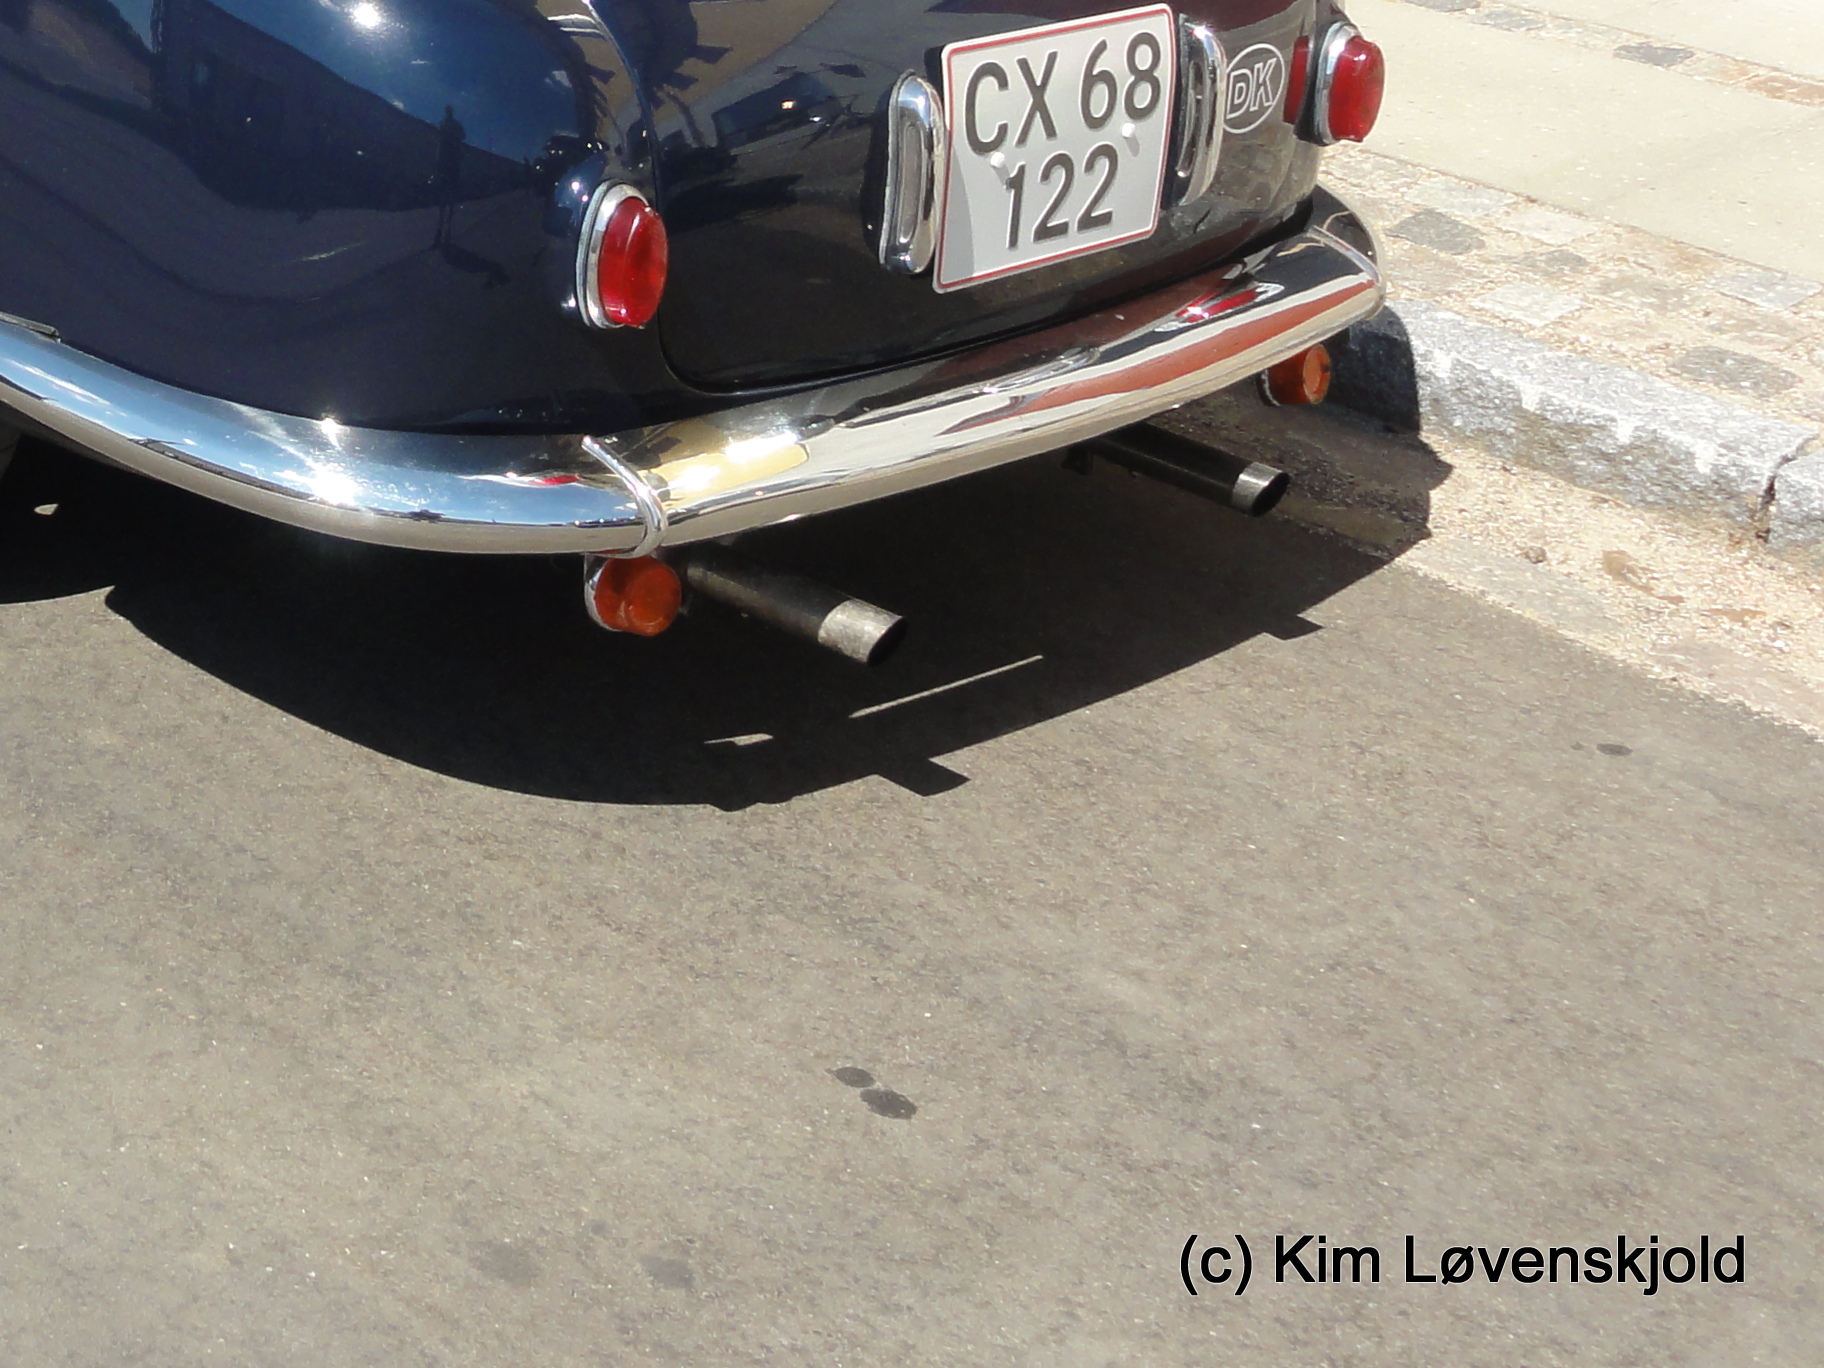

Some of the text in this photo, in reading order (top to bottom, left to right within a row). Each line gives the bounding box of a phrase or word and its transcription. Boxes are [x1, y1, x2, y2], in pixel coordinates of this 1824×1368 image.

[964, 31, 1161, 156] CX 68
[1226, 57, 1277, 120] DK
[1005, 142, 1119, 251] 122
